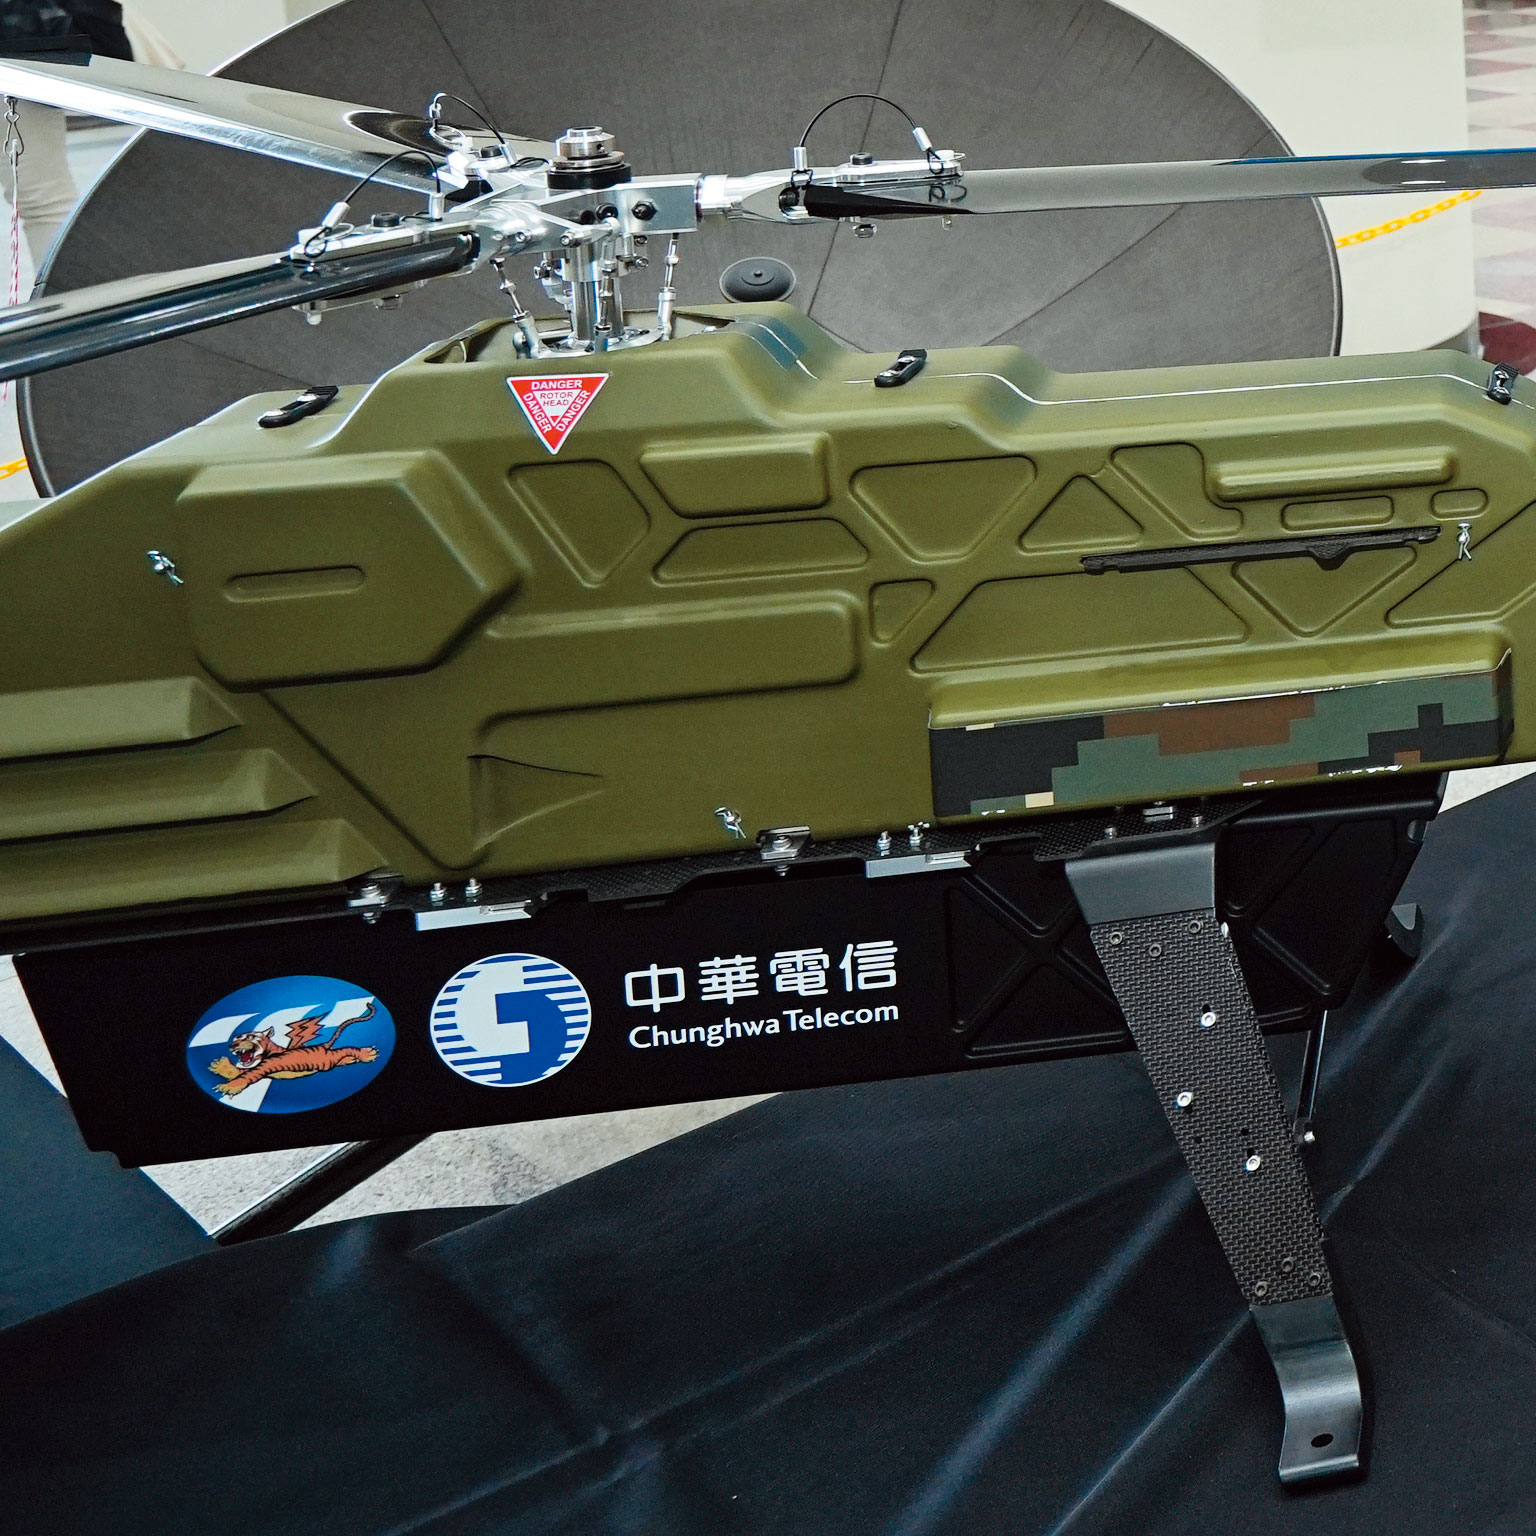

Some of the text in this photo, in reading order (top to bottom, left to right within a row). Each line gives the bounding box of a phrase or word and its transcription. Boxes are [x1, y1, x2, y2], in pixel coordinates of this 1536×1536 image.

[531, 379, 583, 390] DANGER
[540, 391, 574, 400] ROTOR
[542, 399, 569, 407] HEAD
[522, 392, 553, 433] DANGER
[555, 389, 592, 432] DANGER
[624, 940, 899, 1015] 中華電信
[628, 1003, 900, 1052] Chunghwa Telecom
